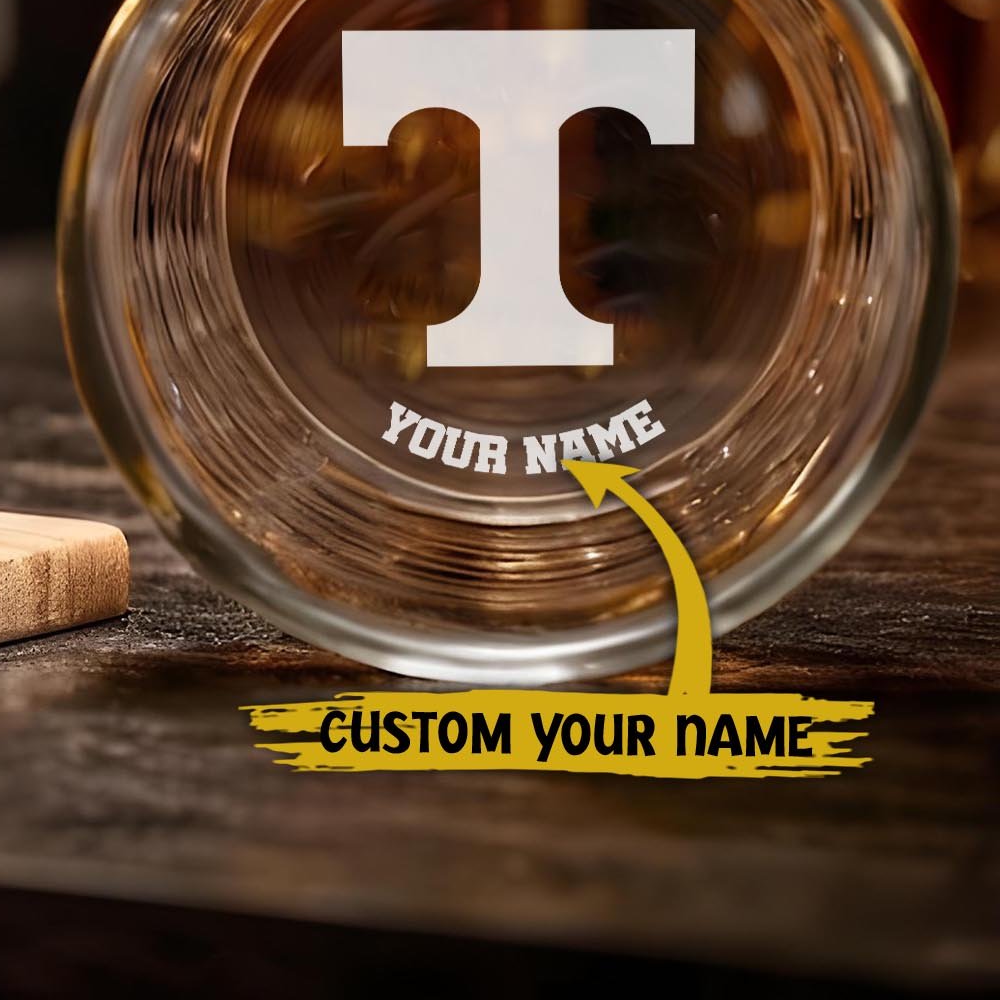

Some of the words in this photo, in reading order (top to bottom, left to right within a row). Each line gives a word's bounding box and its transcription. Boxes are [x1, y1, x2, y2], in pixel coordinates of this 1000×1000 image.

[341, 28, 696, 367] T
[381, 401, 508, 475] YOUR
[523, 399, 666, 475] NAME
